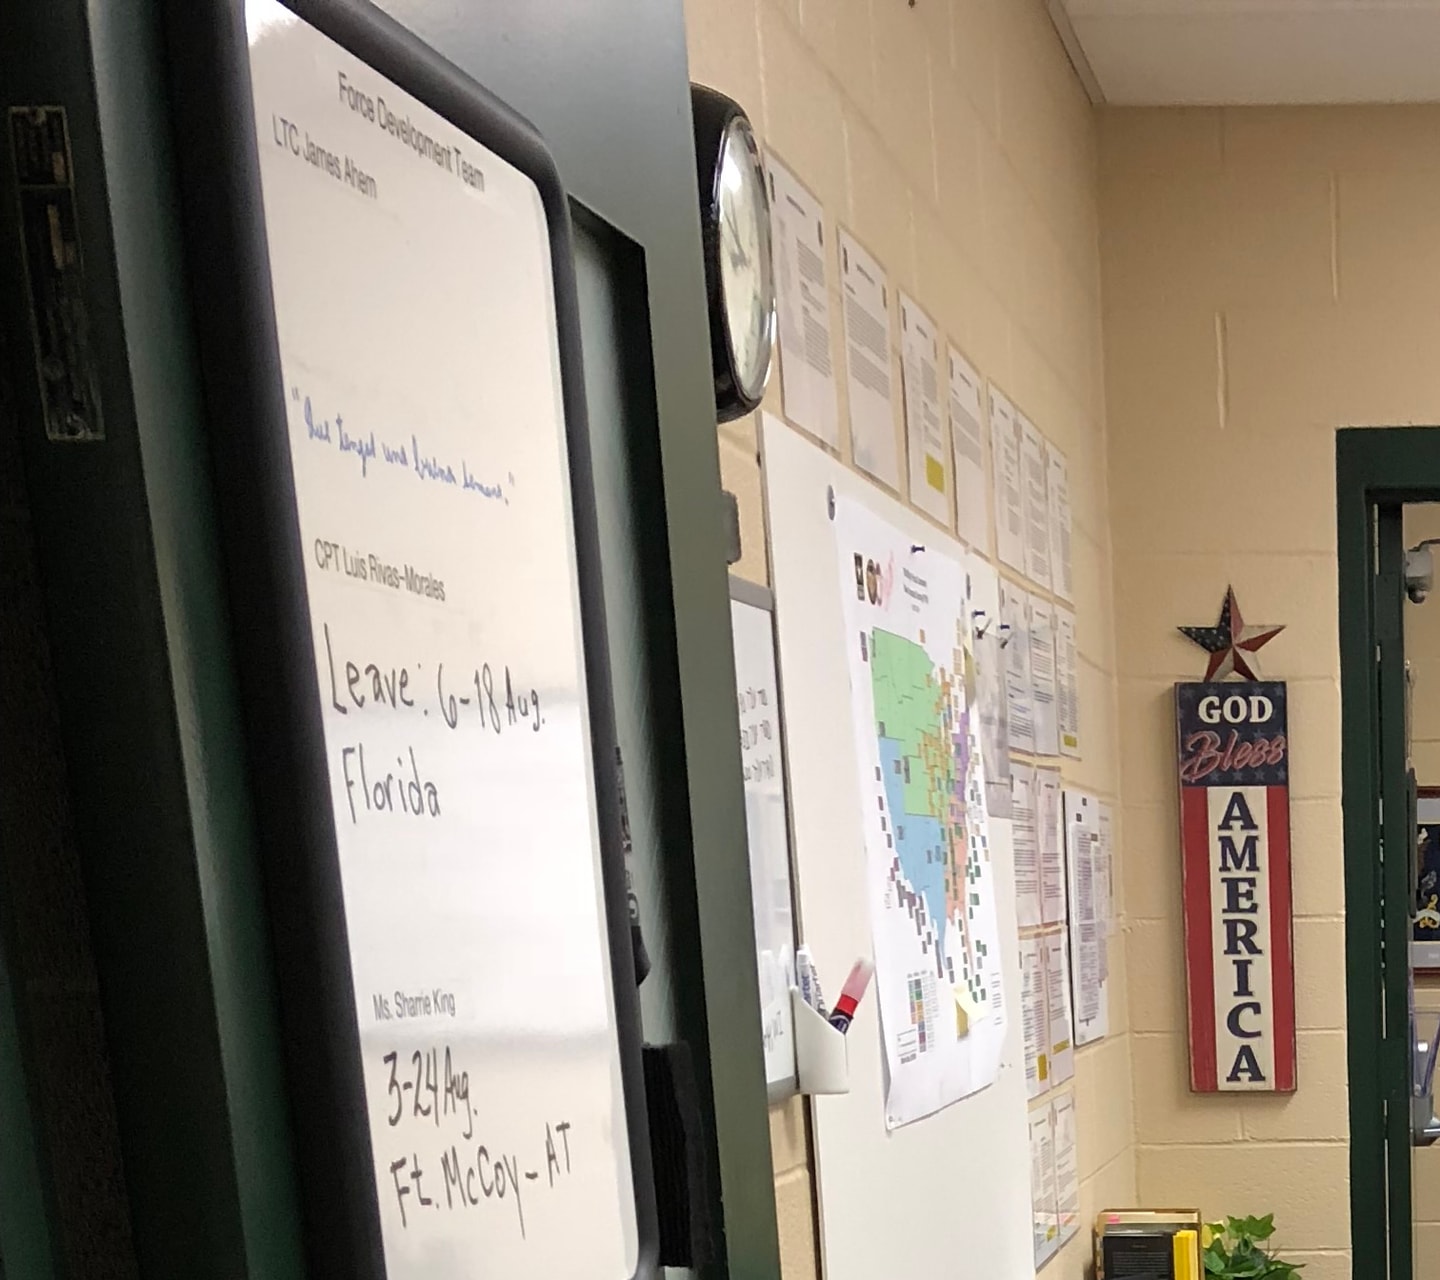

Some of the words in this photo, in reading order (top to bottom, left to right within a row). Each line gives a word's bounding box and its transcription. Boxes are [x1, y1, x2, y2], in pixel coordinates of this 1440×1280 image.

[272, 113, 300, 156] LTC
[303, 132, 341, 180] James
[338, 70, 375, 123] Force
[377, 96, 453, 173] Development
[454, 147, 485, 192] Team
[314, 538, 340, 572] CPT
[343, 546, 367, 581] Luis
[369, 554, 446, 601] Rivas-Morales
[324, 622, 429, 717] Leave:
[438, 662, 501, 734] 6-18
[1198, 695, 1274, 723] GOD
[342, 742, 441, 824] Florida
[1180, 729, 1286, 783] Bless
[1217, 791, 1266, 1083] AMERICA
[373, 994, 392, 1021] Ms.
[432, 989, 456, 1017] King
[383, 1047, 439, 1127] 3-24
[390, 1153, 440, 1228] Ft.
